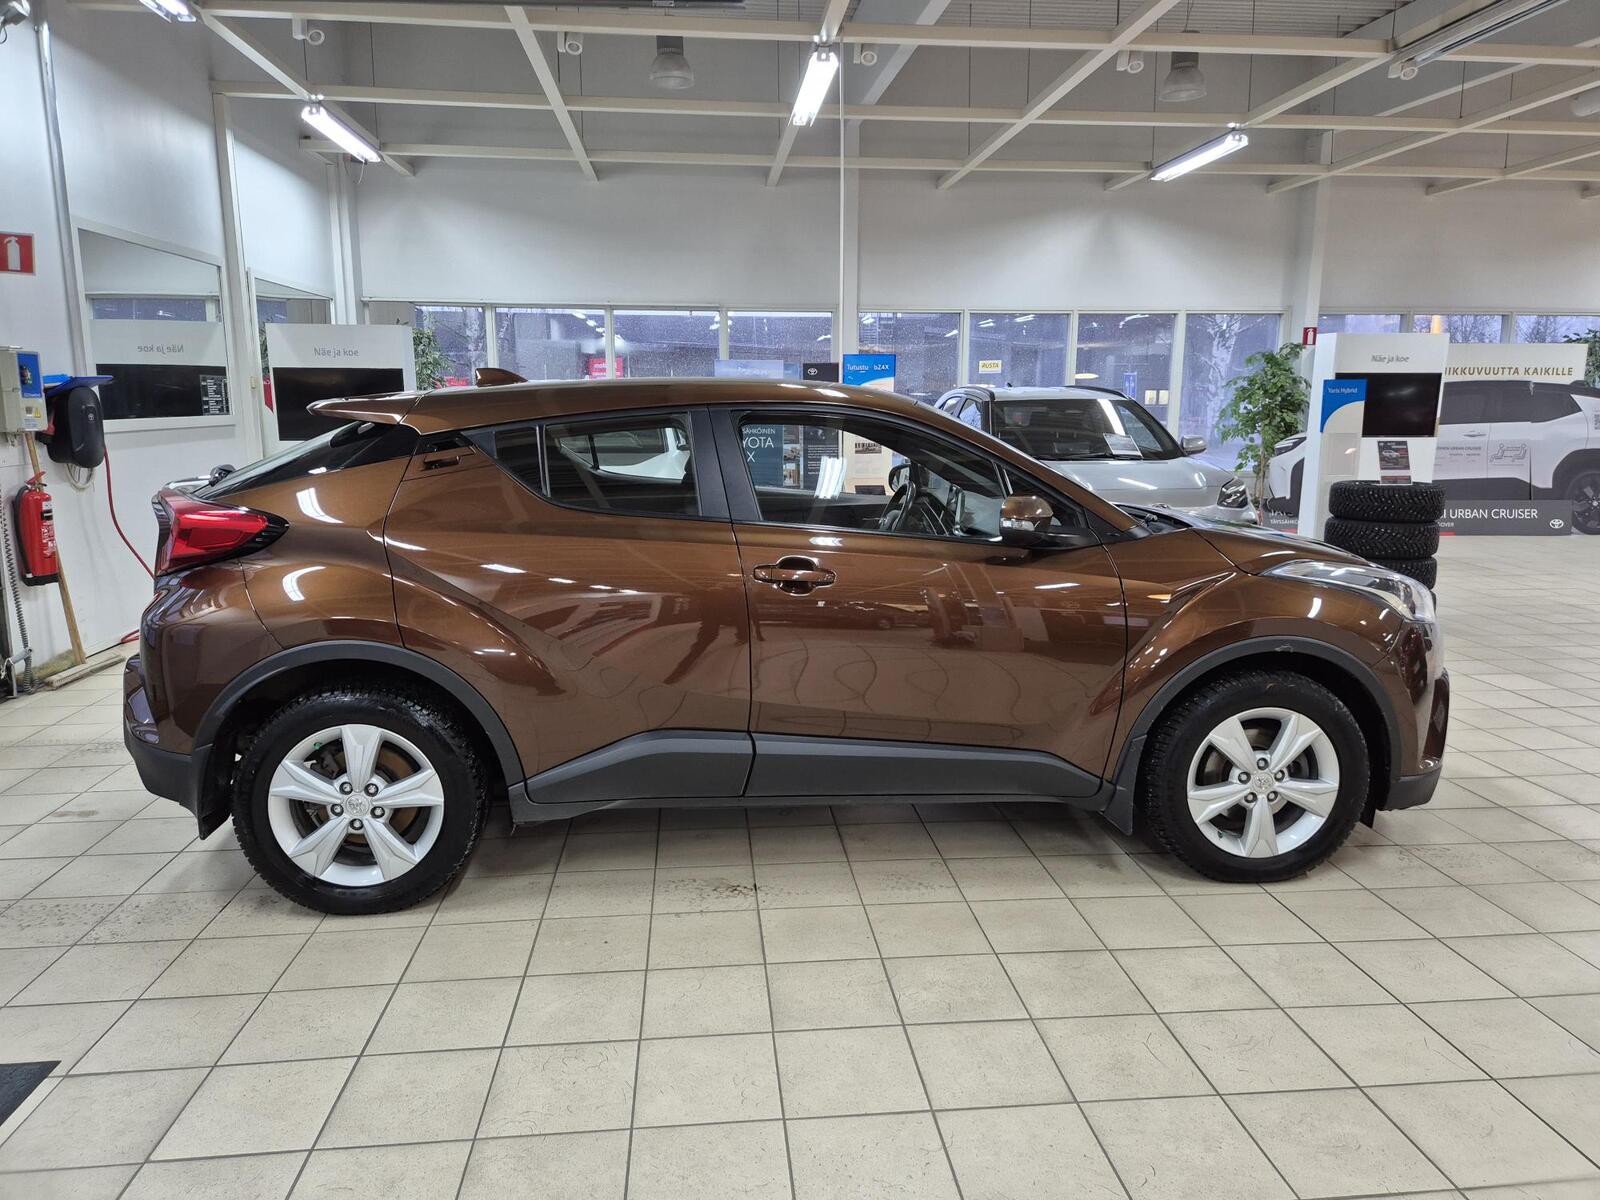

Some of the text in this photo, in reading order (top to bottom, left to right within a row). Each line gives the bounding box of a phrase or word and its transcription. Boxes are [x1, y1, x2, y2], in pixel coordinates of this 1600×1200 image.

[313, 347, 360, 359] Näe ja koe
[1523, 367, 1574, 376] KAIKILLE
[742, 436, 775, 449] YOTA
[1449, 508, 1489, 519] URBAN
[1490, 508, 1539, 519] CRUISER
